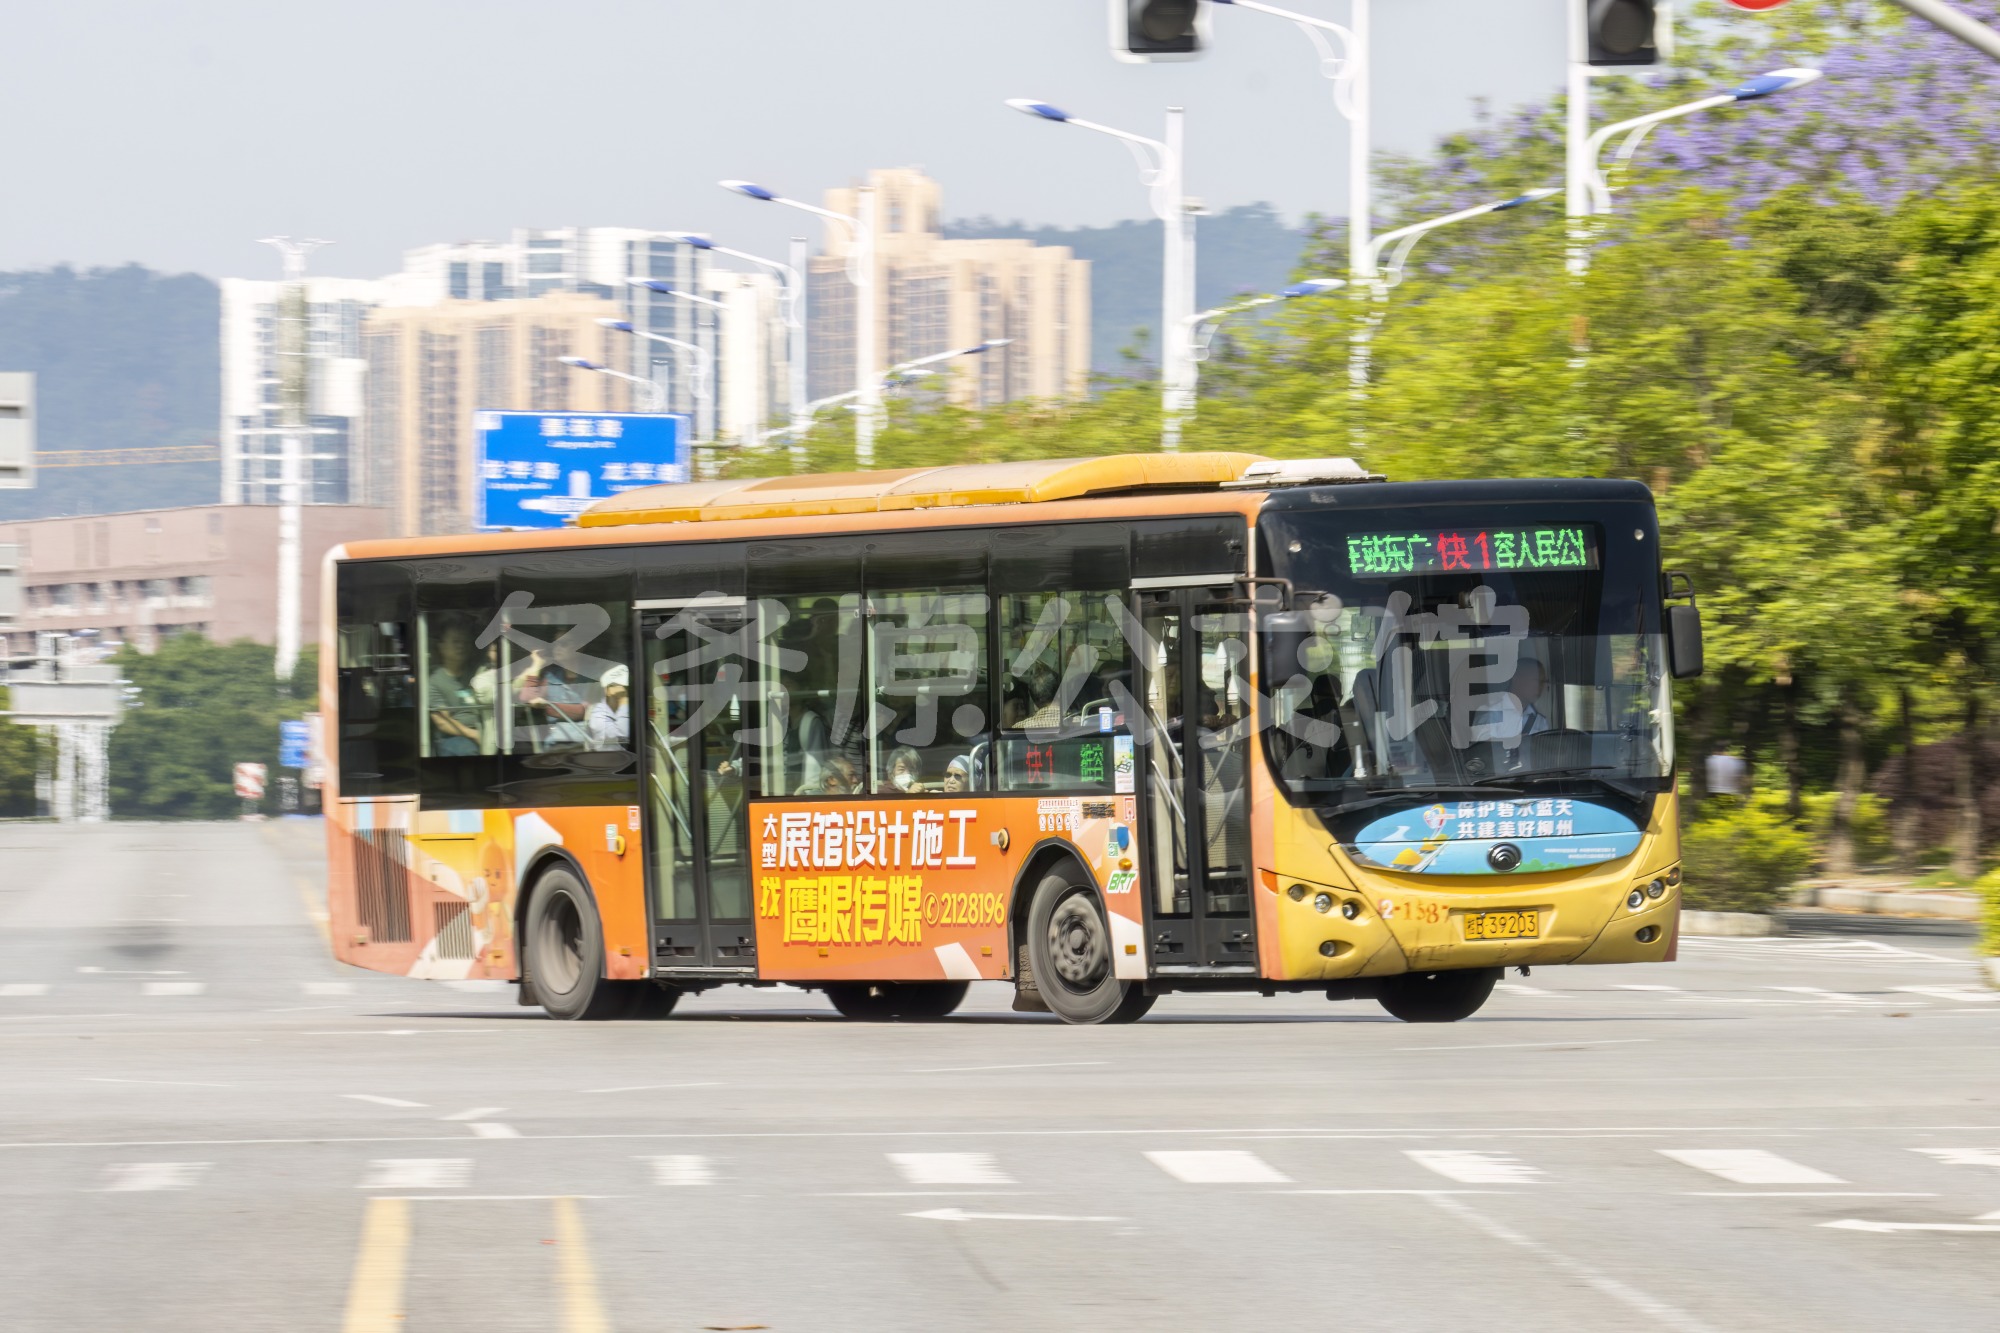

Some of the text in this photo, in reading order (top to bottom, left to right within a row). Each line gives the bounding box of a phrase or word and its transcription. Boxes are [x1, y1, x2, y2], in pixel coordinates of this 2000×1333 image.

[1437, 531, 1490, 571] 快1
[1493, 528, 1587, 569] 容人民公
[1026, 745, 1053, 783] 快1
[1457, 800, 1574, 818] 保护碧水蓝天
[1457, 819, 1574, 839] 共建美好柳州
[762, 814, 778, 868] 大型
[779, 809, 977, 868] 展馆设计施工
[1108, 872, 1137, 891] BRT
[760, 874, 1005, 943] 找 鹰眼传媒 2128196
